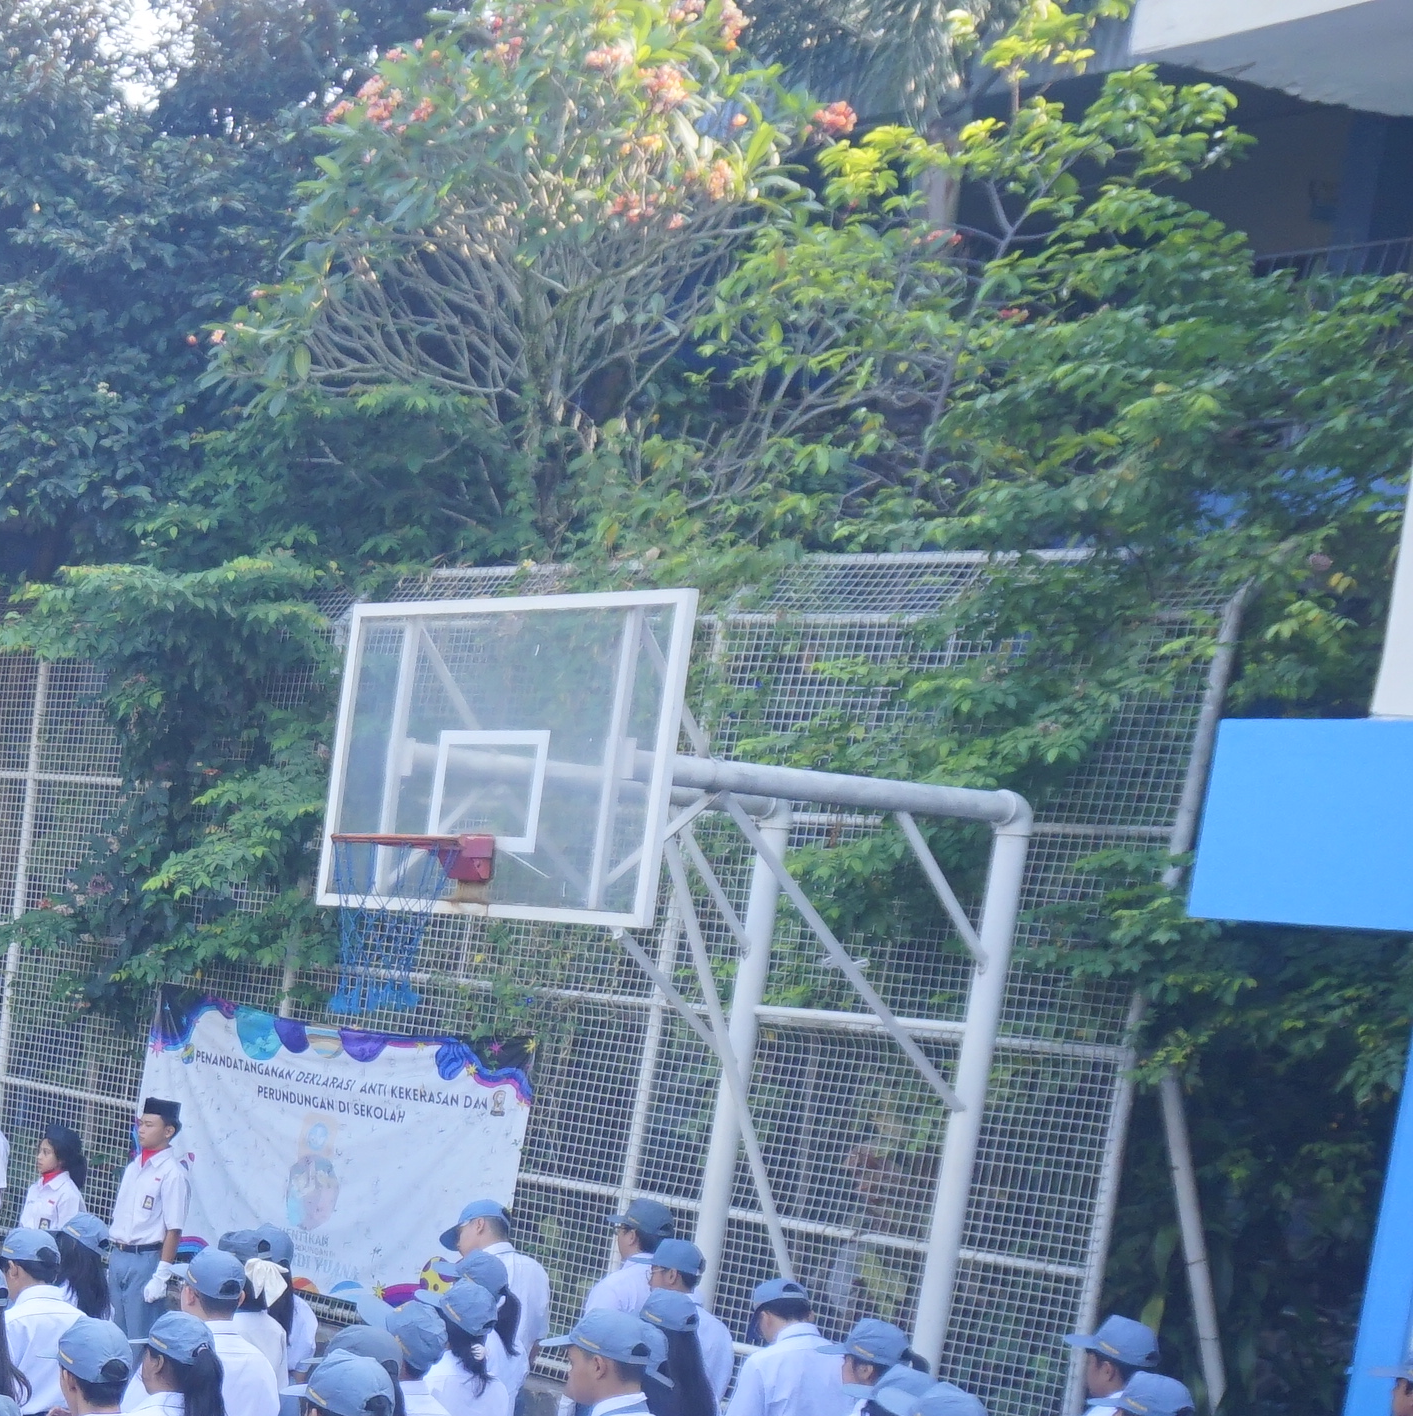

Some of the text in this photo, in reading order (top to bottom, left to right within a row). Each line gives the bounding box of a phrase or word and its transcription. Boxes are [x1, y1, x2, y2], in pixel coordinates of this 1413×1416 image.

[195, 1050, 488, 1111] PENANDATANGANAN DEKLARASI ANTI KEKERASAN DAN
[257, 1085, 405, 1124] PERUNDUNGAN DI SEKOLAH
